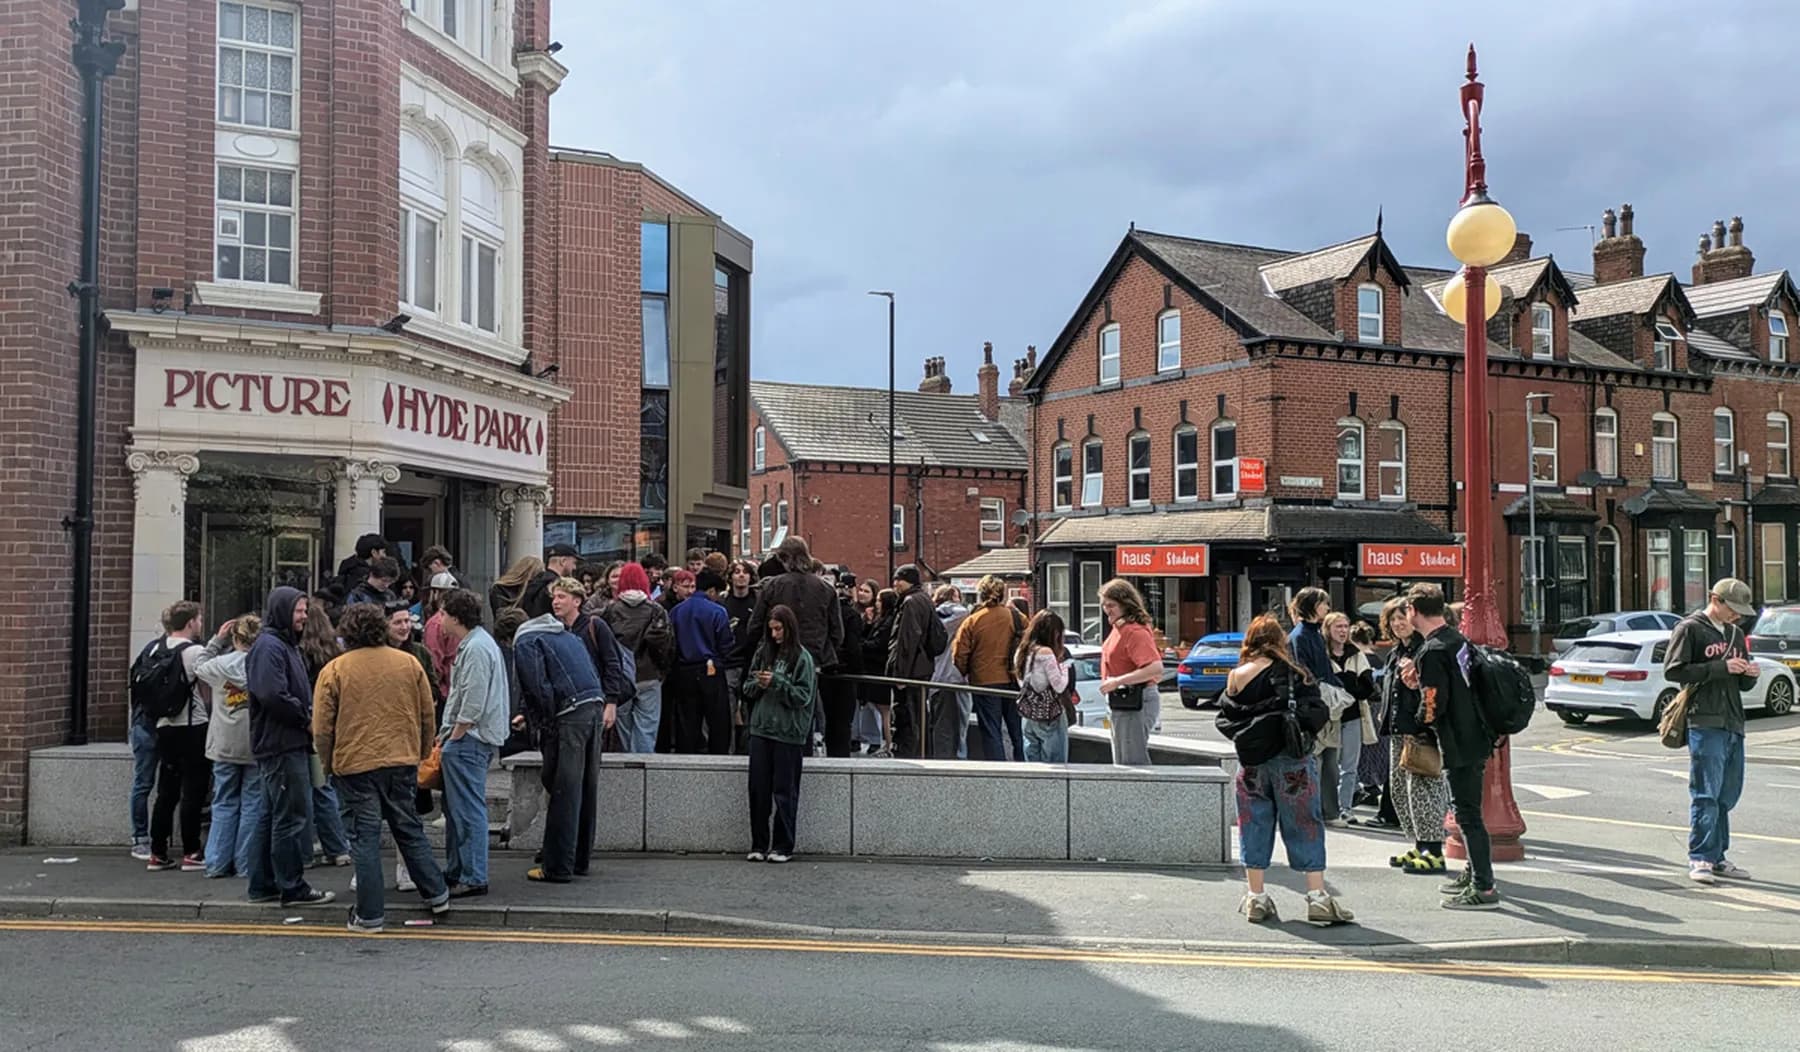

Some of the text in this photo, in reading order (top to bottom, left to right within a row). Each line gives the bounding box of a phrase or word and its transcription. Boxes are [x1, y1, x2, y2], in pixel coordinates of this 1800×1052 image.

[164, 368, 351, 417] PICTURE
[397, 385, 533, 455] HYDE PARK
[1121, 550, 1200, 566] haus Student
[1367, 547, 1456, 567] haus Student
